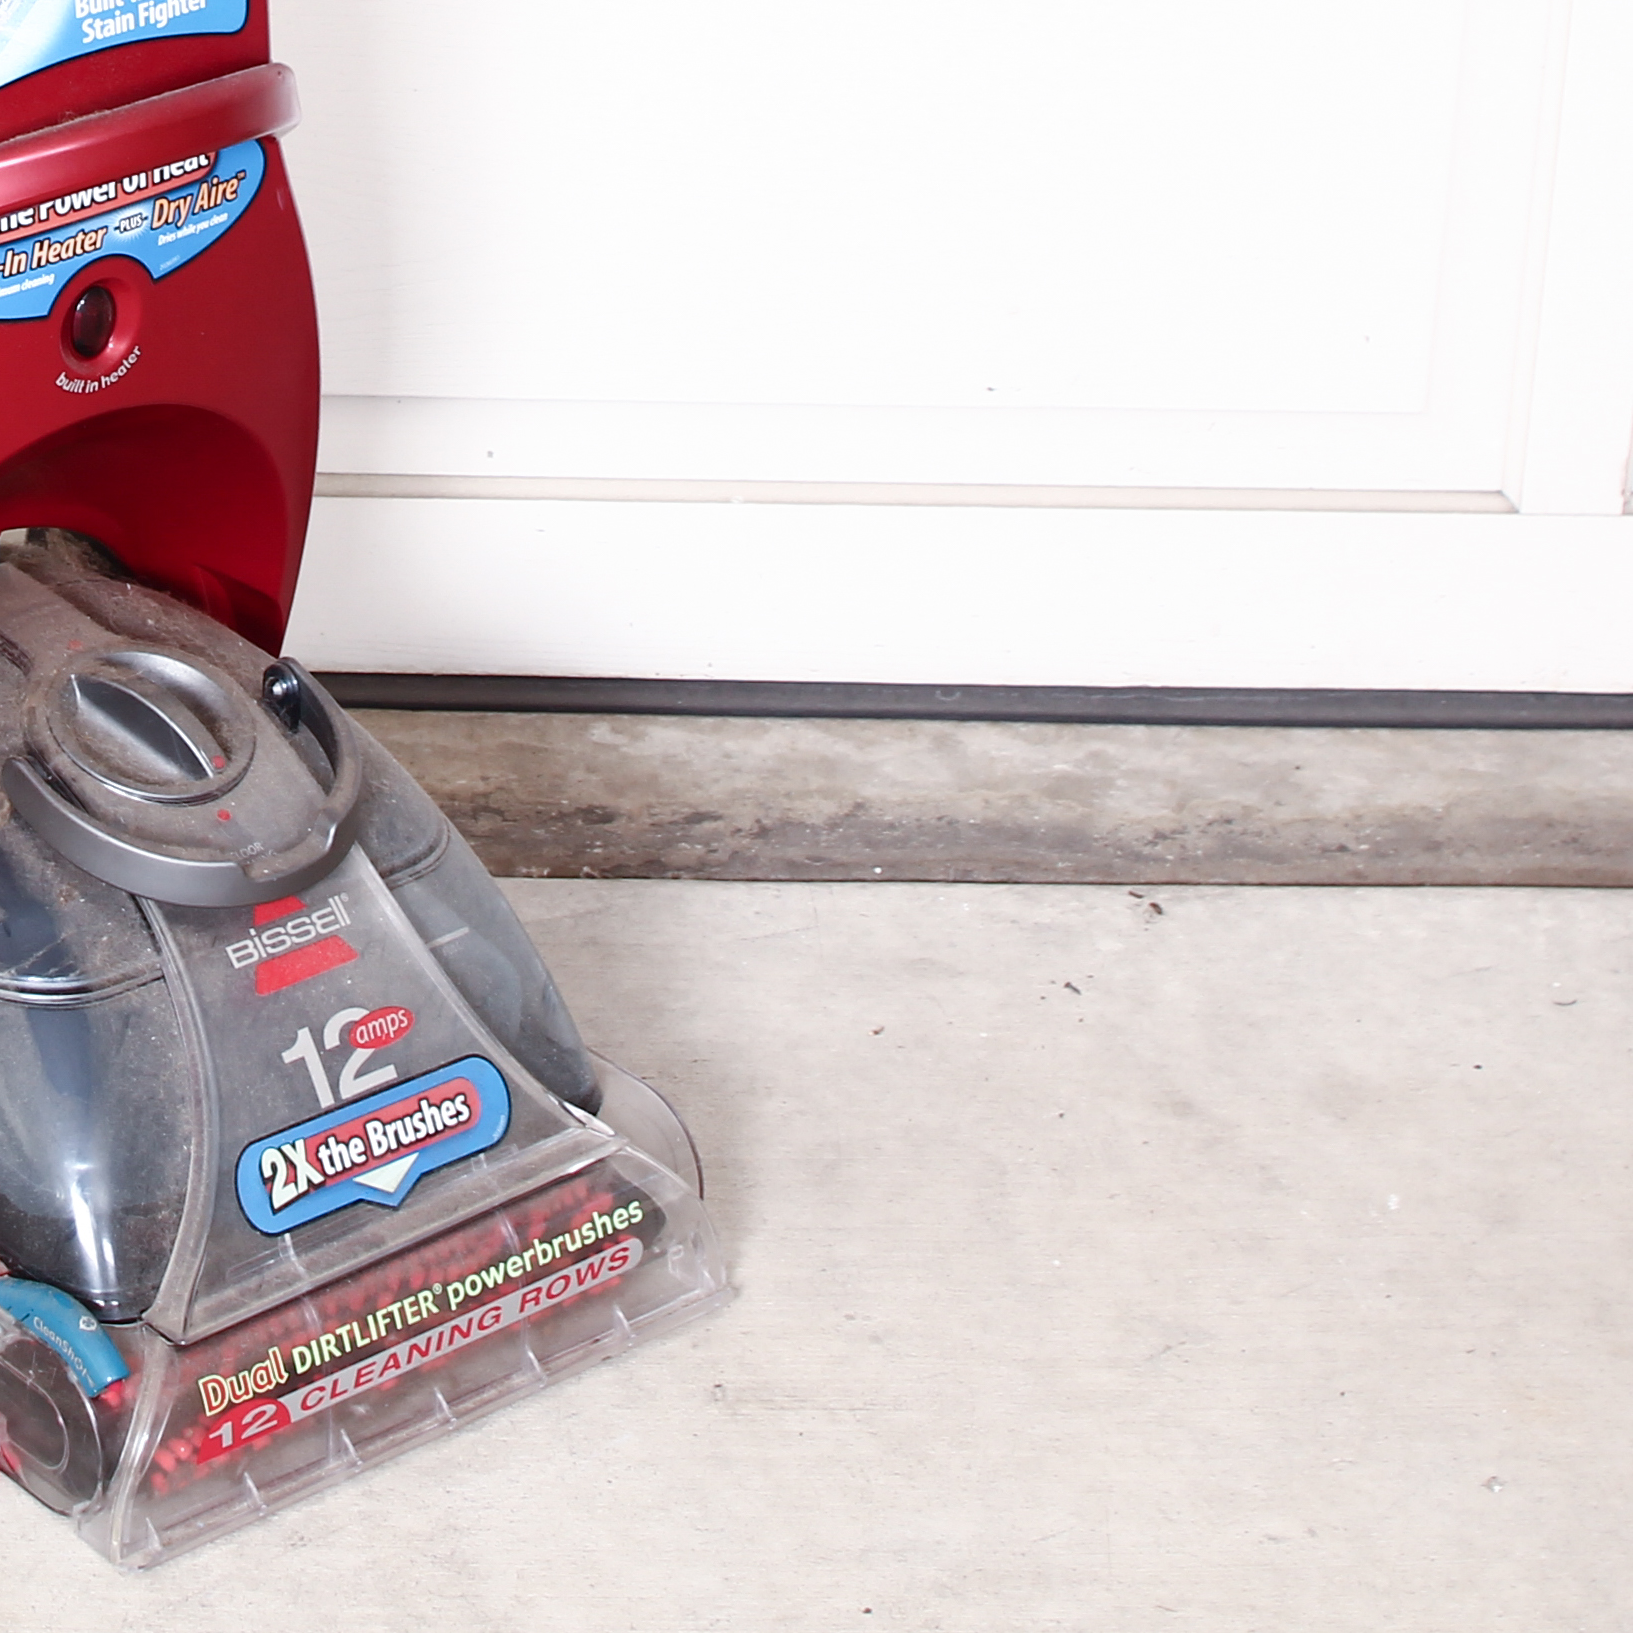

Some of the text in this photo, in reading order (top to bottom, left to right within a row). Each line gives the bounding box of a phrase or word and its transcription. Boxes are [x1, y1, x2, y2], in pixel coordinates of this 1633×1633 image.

[82, 12, 135, 44] Stain
[31, 224, 108, 270] Heater
[151, 193, 193, 230] Dry
[195, 219, 210, 235] you
[209, 212, 229, 227] clean
[21, 272, 56, 292] cleaning
[55, 345, 142, 394] built in heater
[281, 1007, 409, 1109] 12 amps
[260, 1137, 326, 1212] 2X
[317, 1134, 367, 1176] the
[365, 1092, 471, 1158] Brushes
[198, 1199, 645, 1416] Dual DIRTLIFTER powerbrushes
[208, 1246, 632, 1449] 12 CLEANING ROWS
